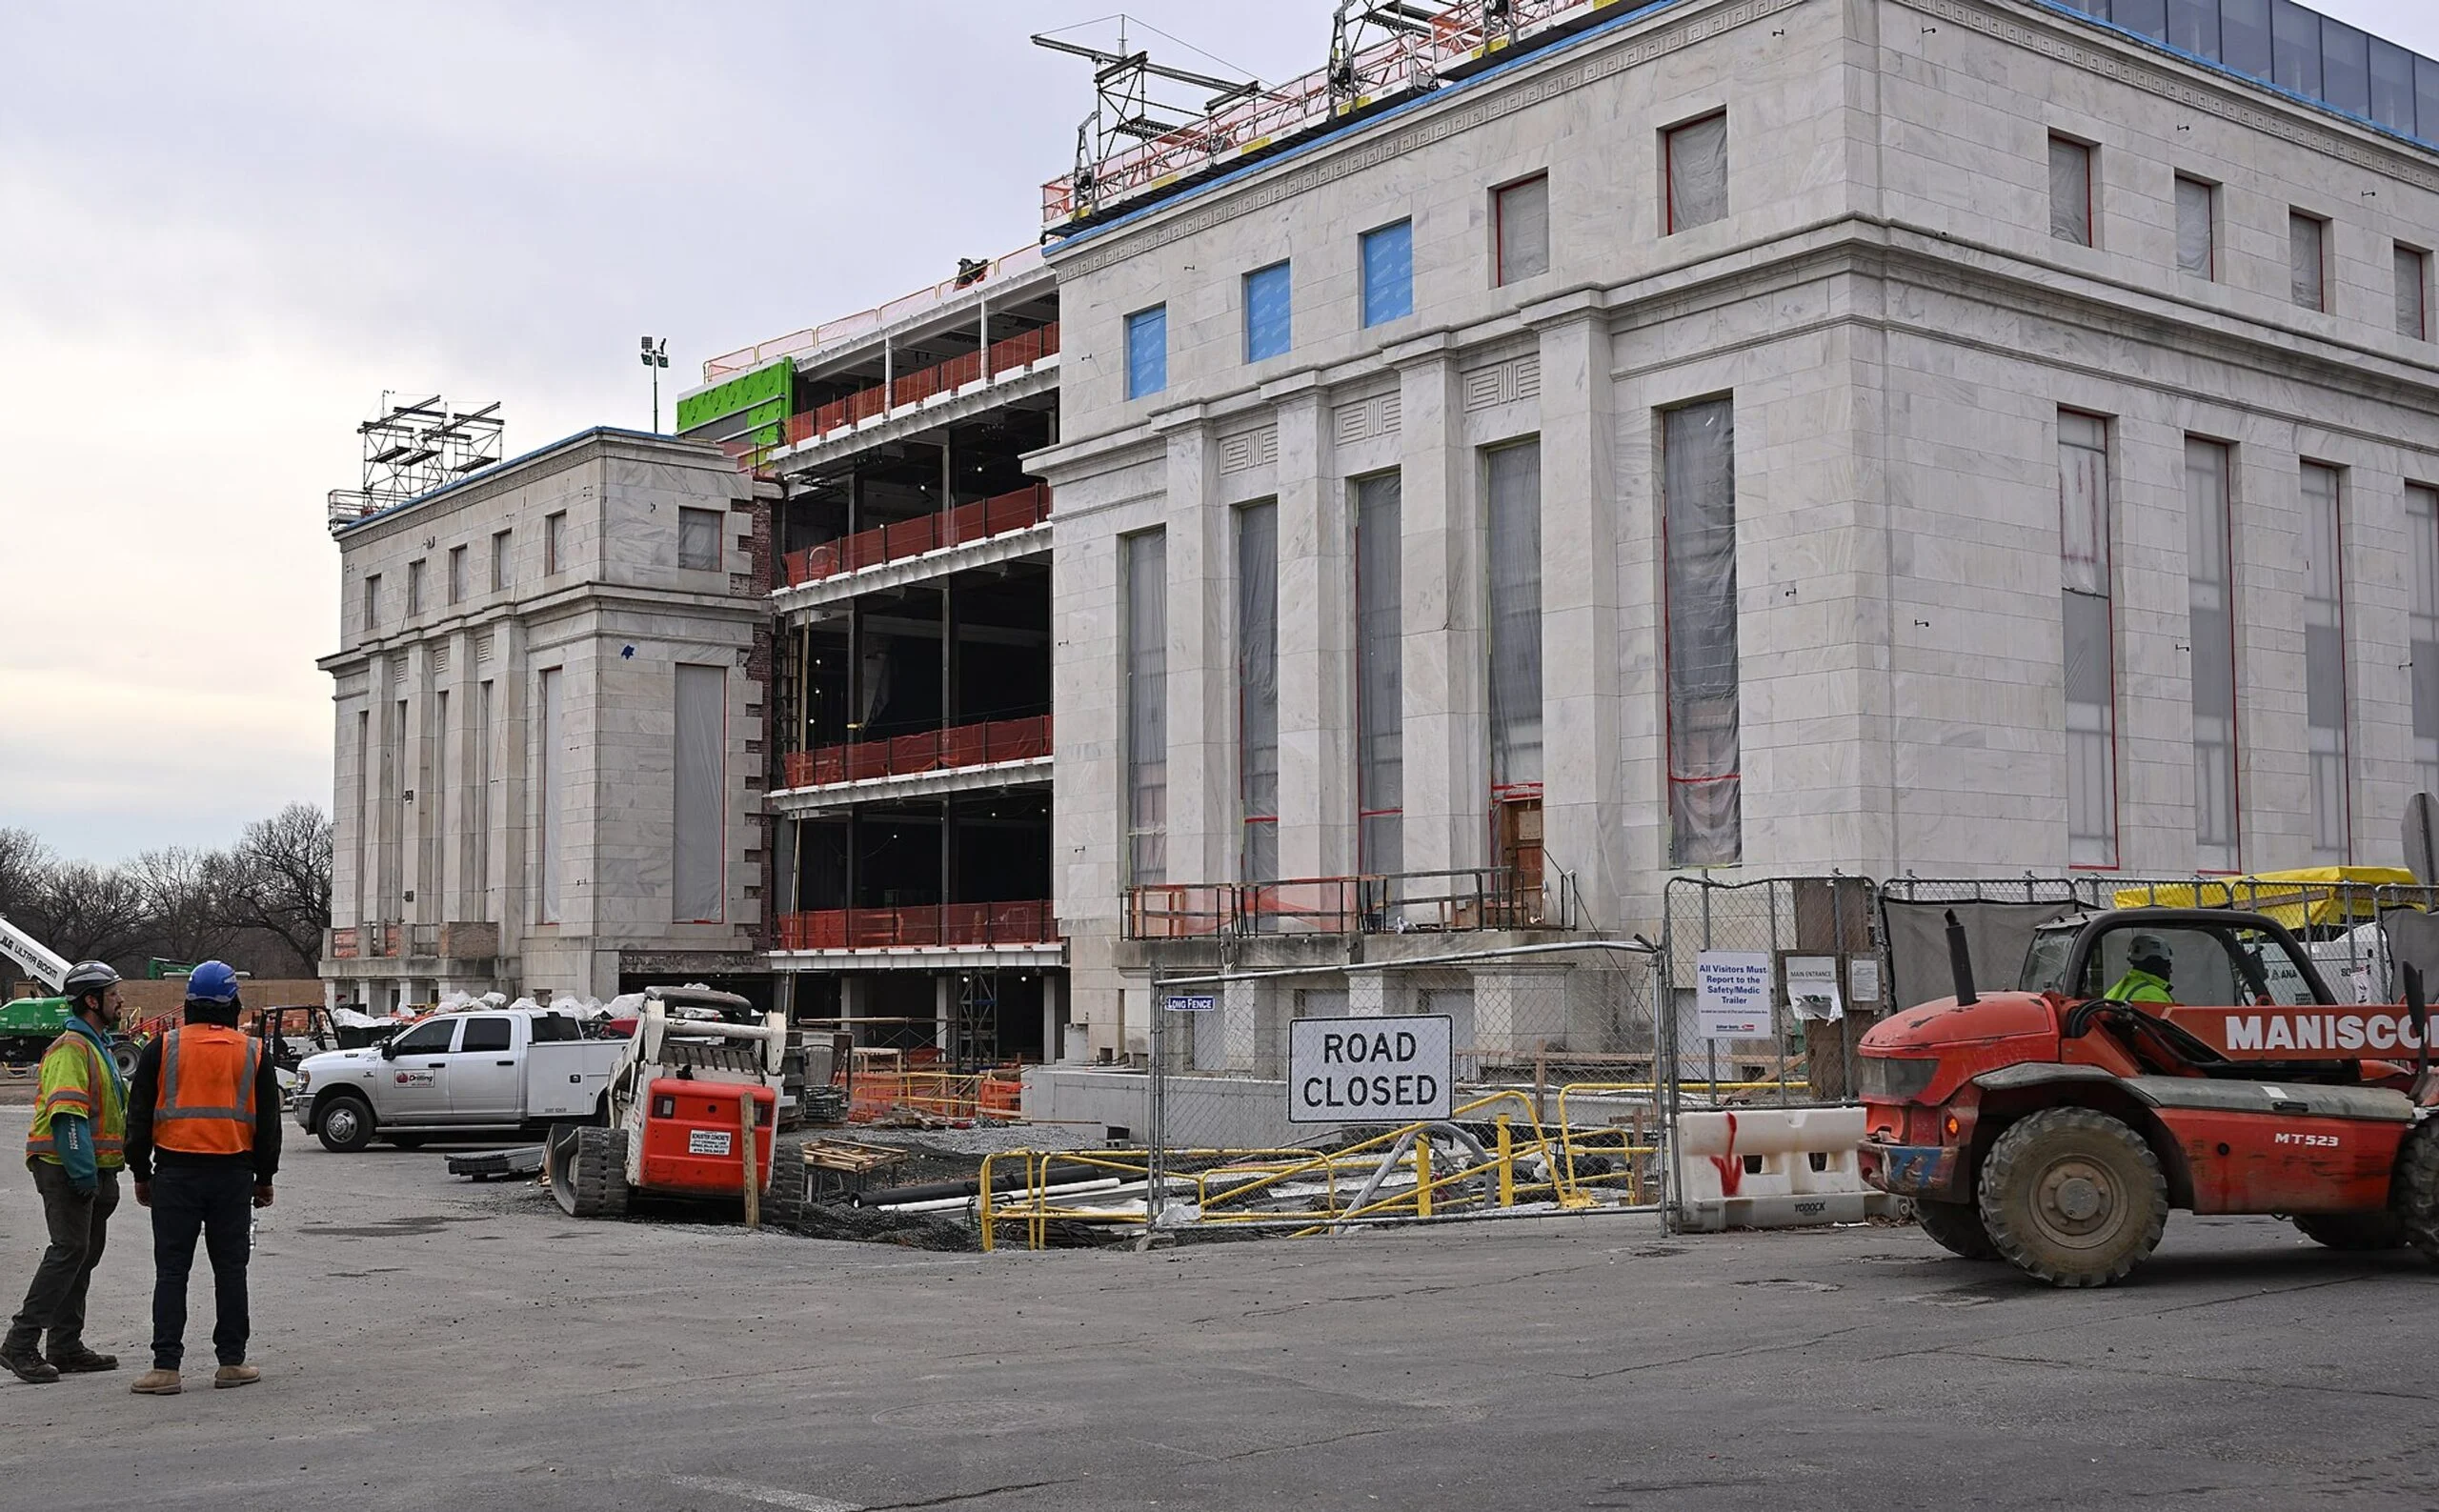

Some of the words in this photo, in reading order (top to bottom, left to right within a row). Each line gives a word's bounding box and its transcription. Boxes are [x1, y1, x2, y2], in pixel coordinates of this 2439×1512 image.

[14, 944, 37, 965] ULTRA
[36, 959, 58, 979] BOOM
[1699, 964, 1711, 973] All
[1712, 964, 1744, 973] Visitors
[1745, 965, 1766, 974] Must
[1706, 975, 1734, 984] Report
[1746, 976, 1761, 984] the
[1706, 985, 1761, 995] Safety/Medic
[1721, 996, 1747, 1004] Trailer
[1323, 1032, 1417, 1063] ROAD
[1303, 1075, 1438, 1107] CLOSED
[1794, 1201, 1825, 1212] YODOCK
